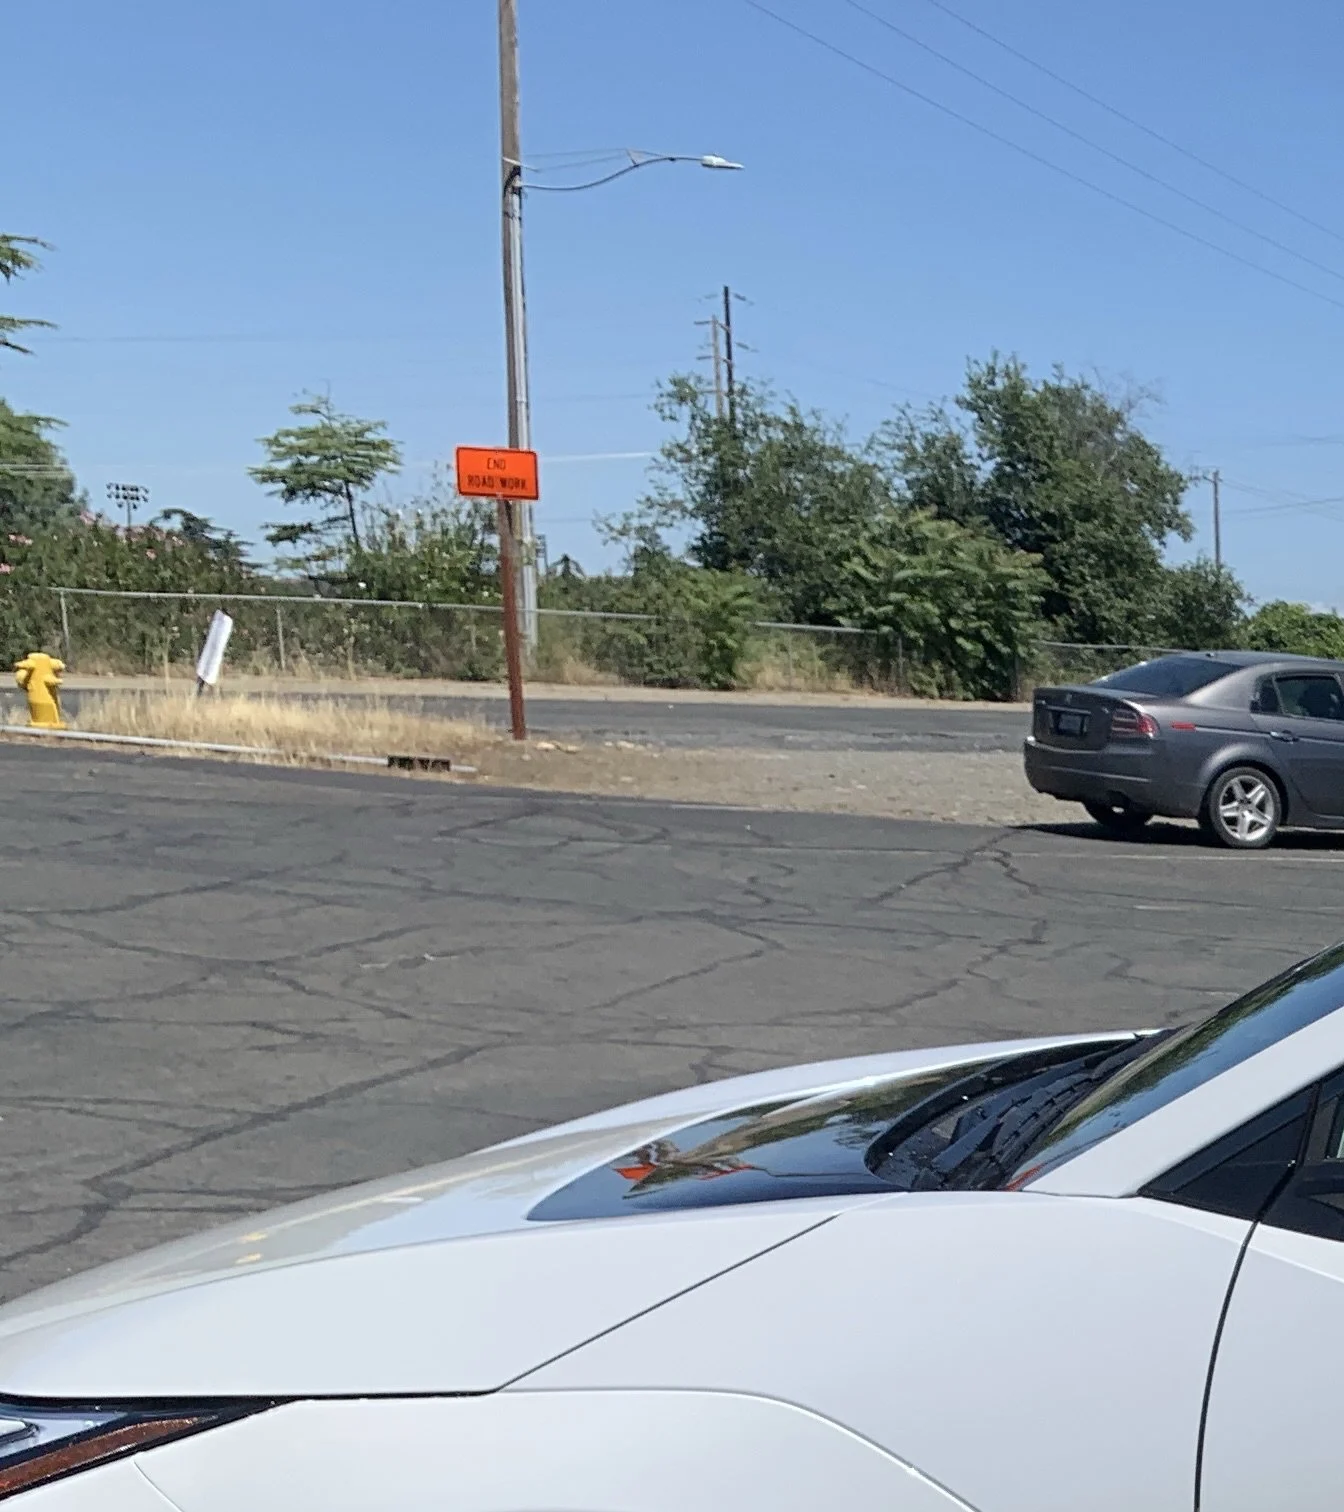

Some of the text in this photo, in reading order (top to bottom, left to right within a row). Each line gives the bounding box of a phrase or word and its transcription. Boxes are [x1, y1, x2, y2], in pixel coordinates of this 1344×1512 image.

[486, 457, 507, 470] END
[467, 474, 527, 490] ROAD WORK
